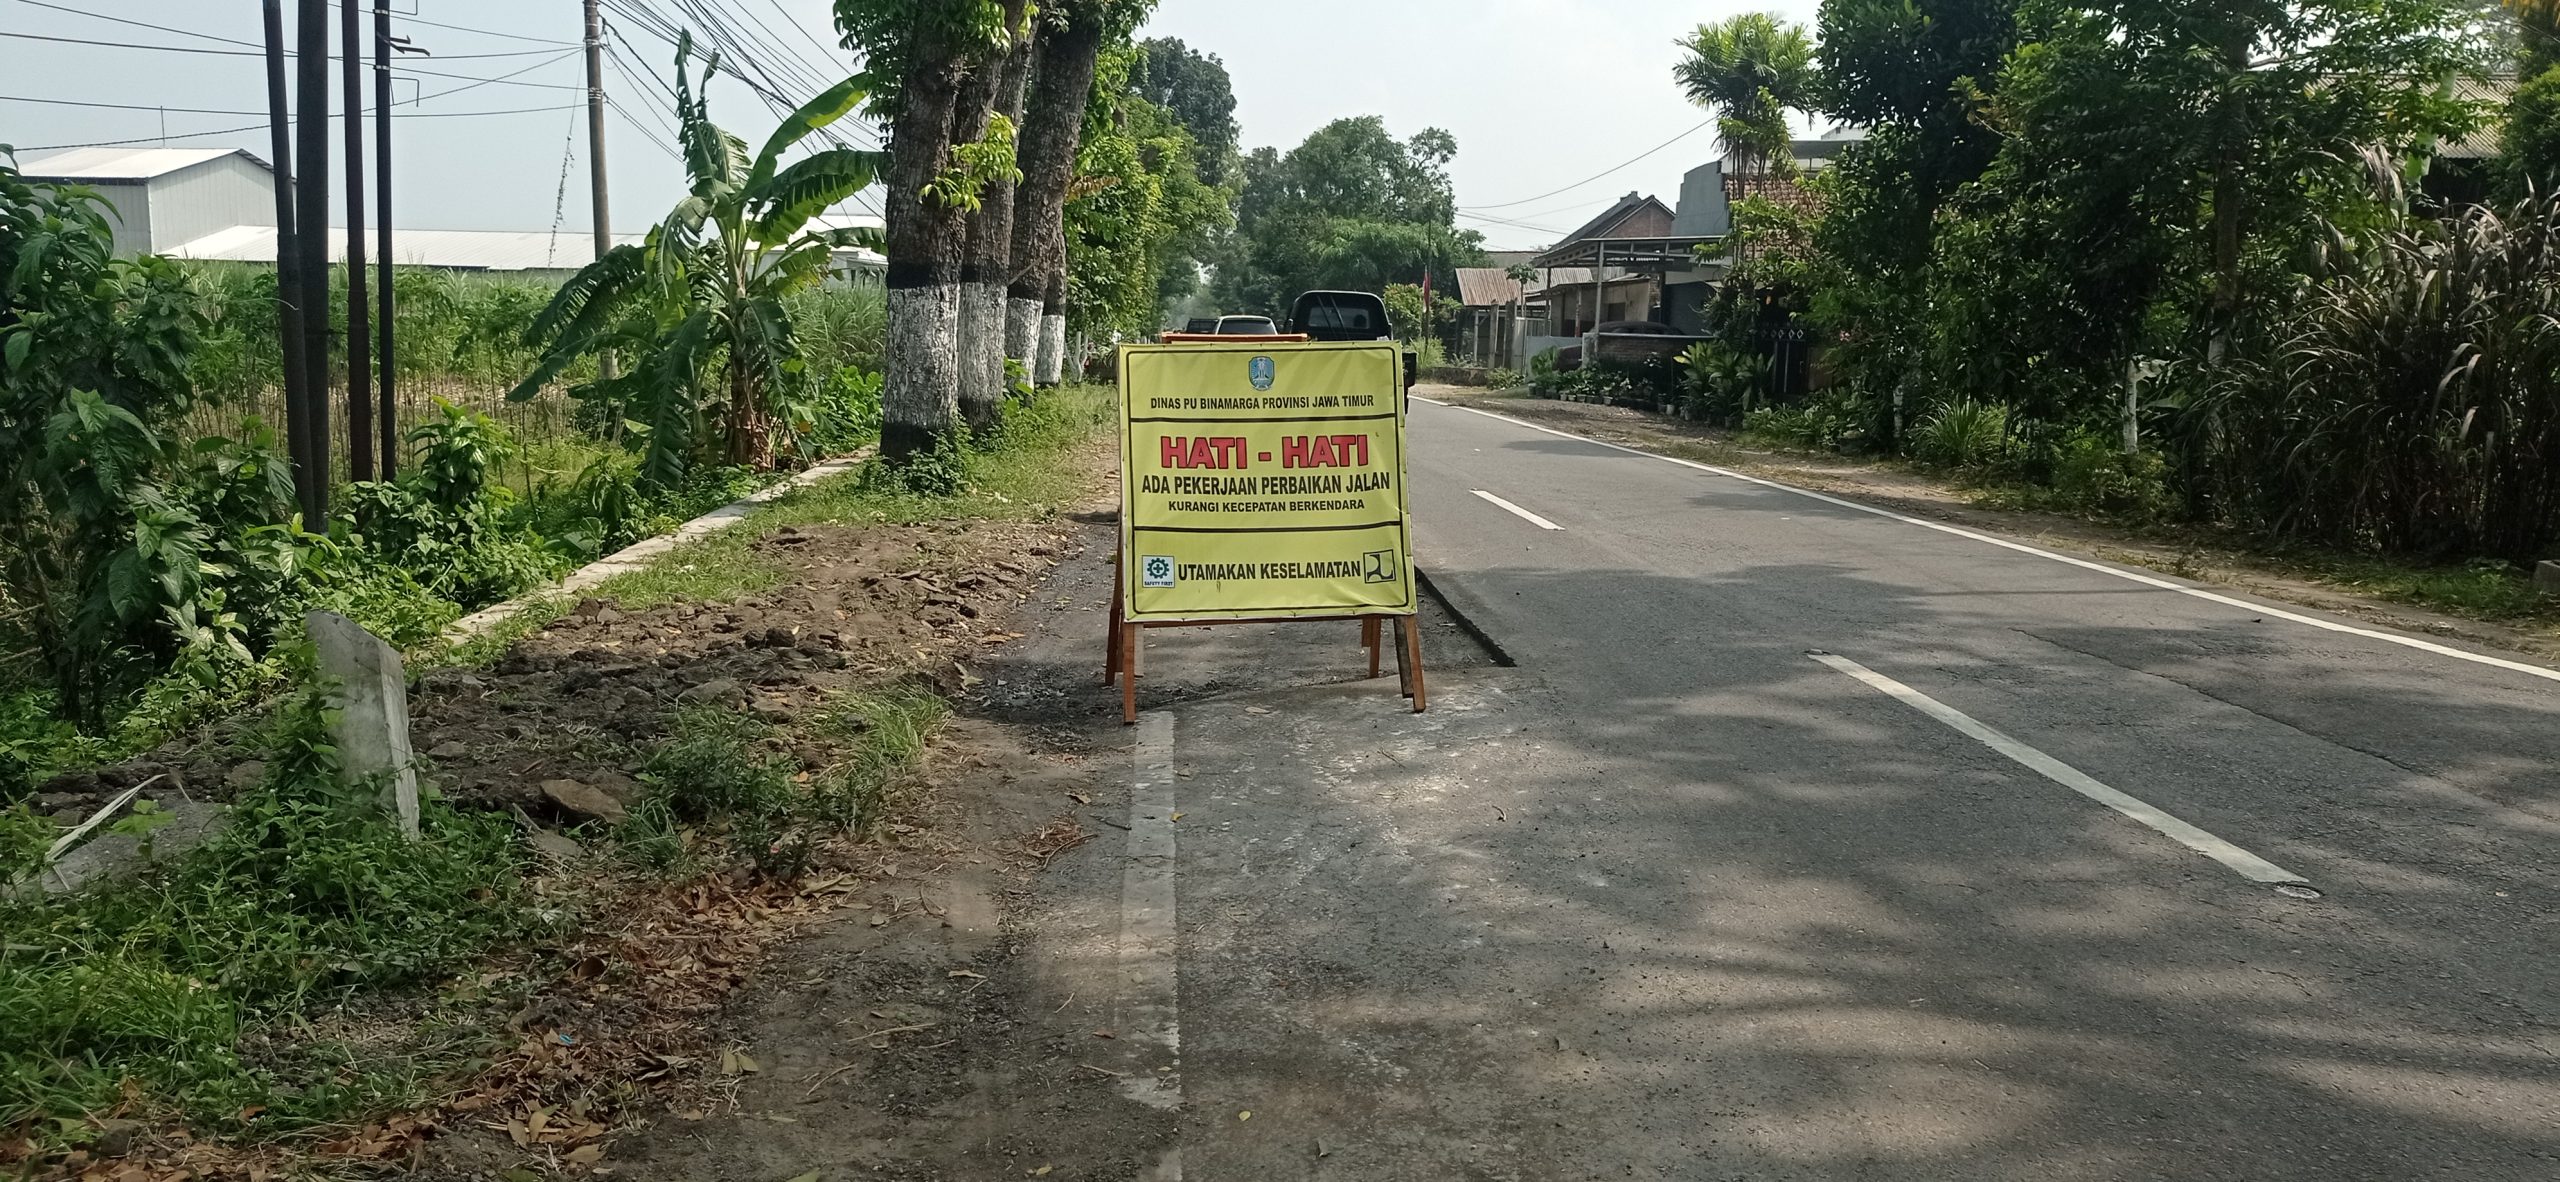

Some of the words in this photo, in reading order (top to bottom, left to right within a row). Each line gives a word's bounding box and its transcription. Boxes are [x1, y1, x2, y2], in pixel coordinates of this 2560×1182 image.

[1150, 397, 1181, 409] DINAS
[1183, 397, 1198, 409] PU
[1199, 397, 1260, 409] BINAMARGA
[1262, 396, 1309, 409] PROVINSI
[1311, 395, 1340, 408] JAWA
[1342, 394, 1374, 407] TIMUR
[1160, 435, 1248, 470] HATI
[1281, 434, 1369, 469] HATI
[1141, 475, 1170, 494] ADA
[1174, 476, 1257, 495] PEKERJAAN
[1261, 475, 1342, 495] PERBAIKAN
[1345, 471, 1390, 493] JALAN
[1168, 501, 1219, 512] KURANGI
[1222, 501, 1286, 513] KECEPATAN
[1289, 499, 1365, 512] BERKENDARA
[1177, 563, 1256, 581] UTAMAKAN
[1260, 560, 1361, 579] KESELAMATAN
